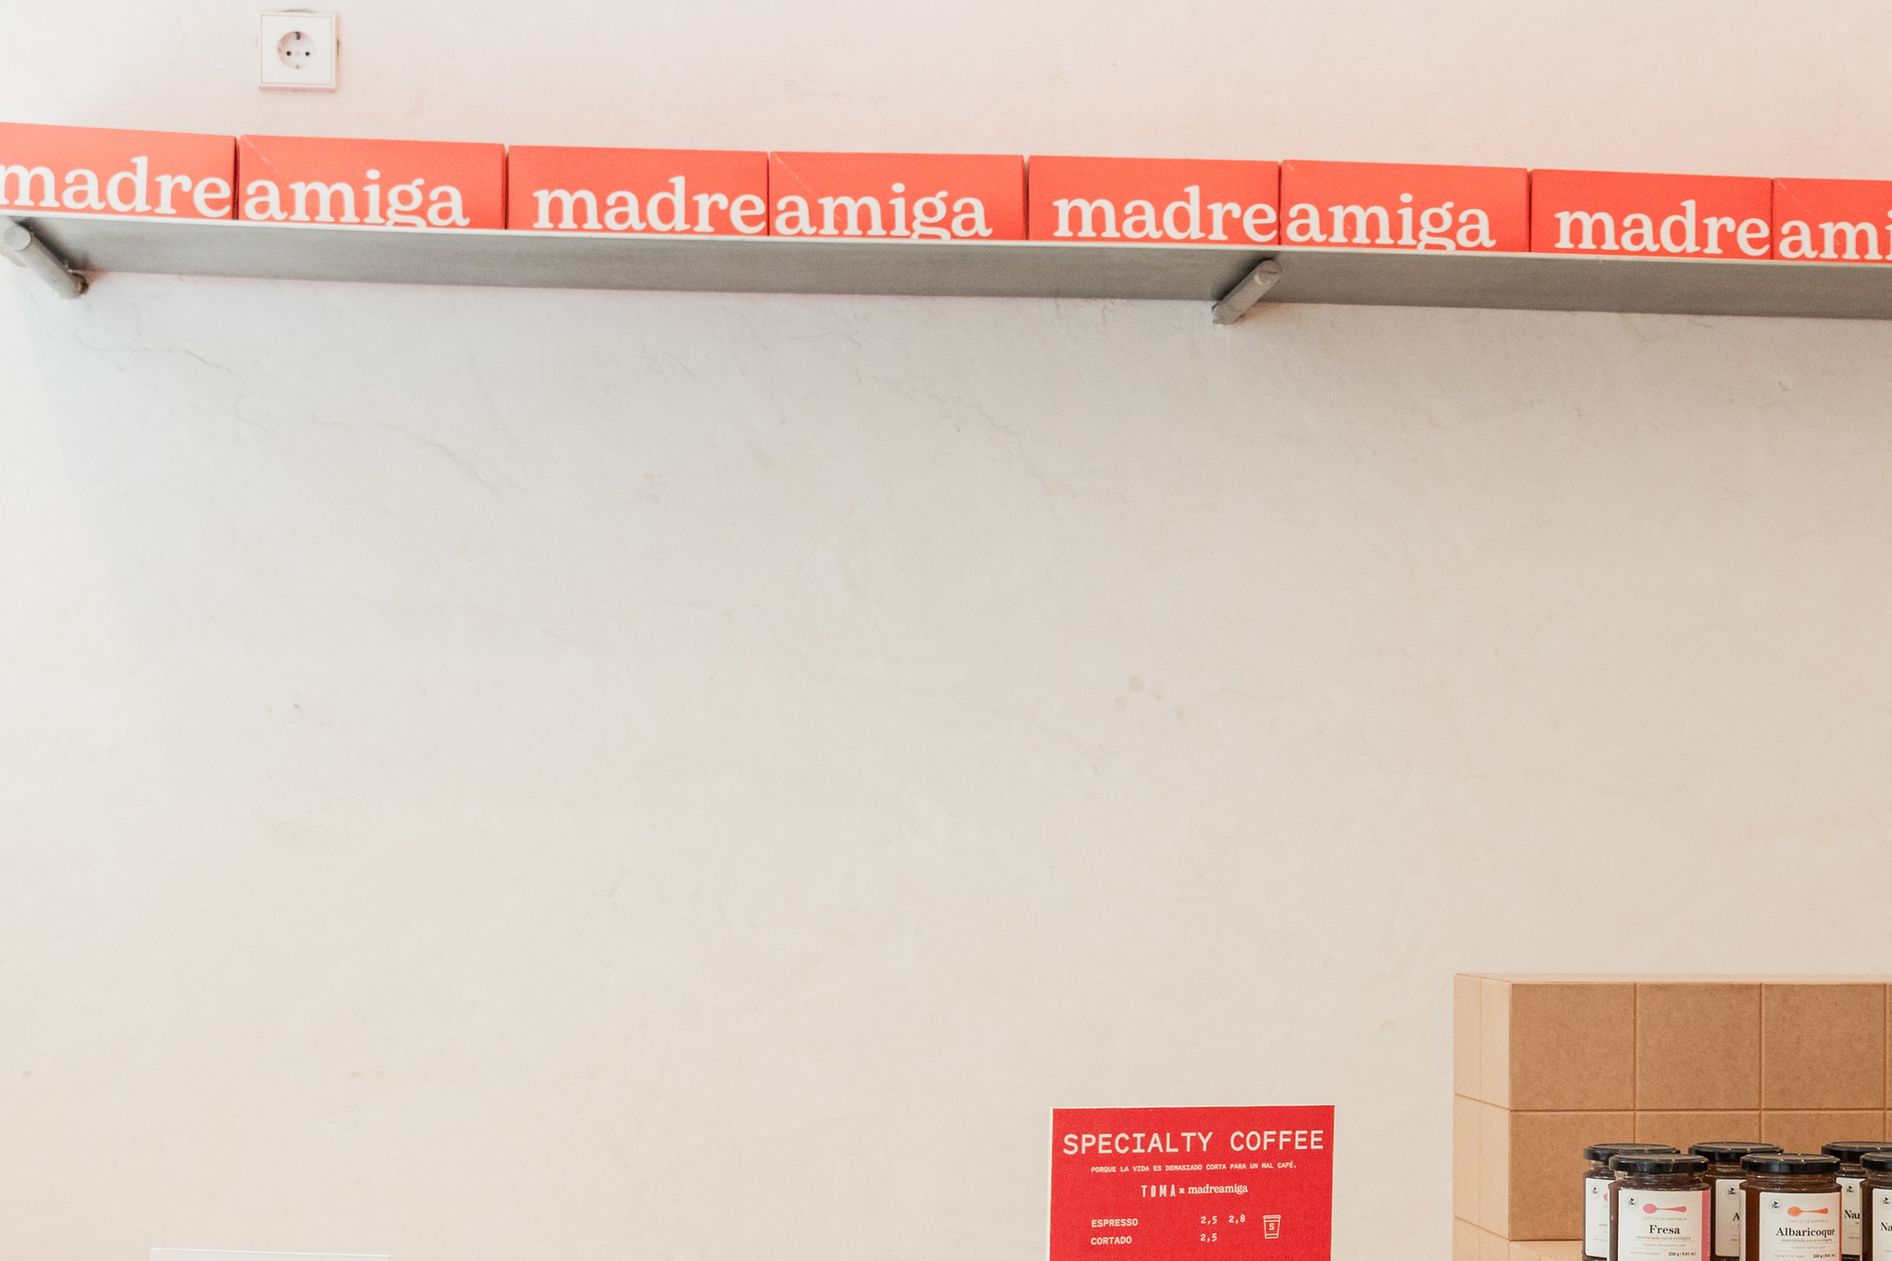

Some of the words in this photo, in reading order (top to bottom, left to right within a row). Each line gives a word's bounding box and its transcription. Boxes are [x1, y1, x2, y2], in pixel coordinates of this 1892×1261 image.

[1063, 1132, 1214, 1154] SPECIALTY
[1230, 1130, 1324, 1151] COFFEE
[1142, 1184, 1176, 1198] TOMA
[1188, 1184, 1248, 1194] madreamiga
[1091, 1218, 1138, 1228] ESPRESSO
[1201, 1216, 1217, 1224] 2,5
[1228, 1214, 1245, 1224] 2,8
[1649, 1225, 1680, 1234] Fresa
[1776, 1227, 1835, 1237] Albaricoque
[1090, 1236, 1132, 1245] CORTADO
[1200, 1234, 1217, 1242] 2,5
